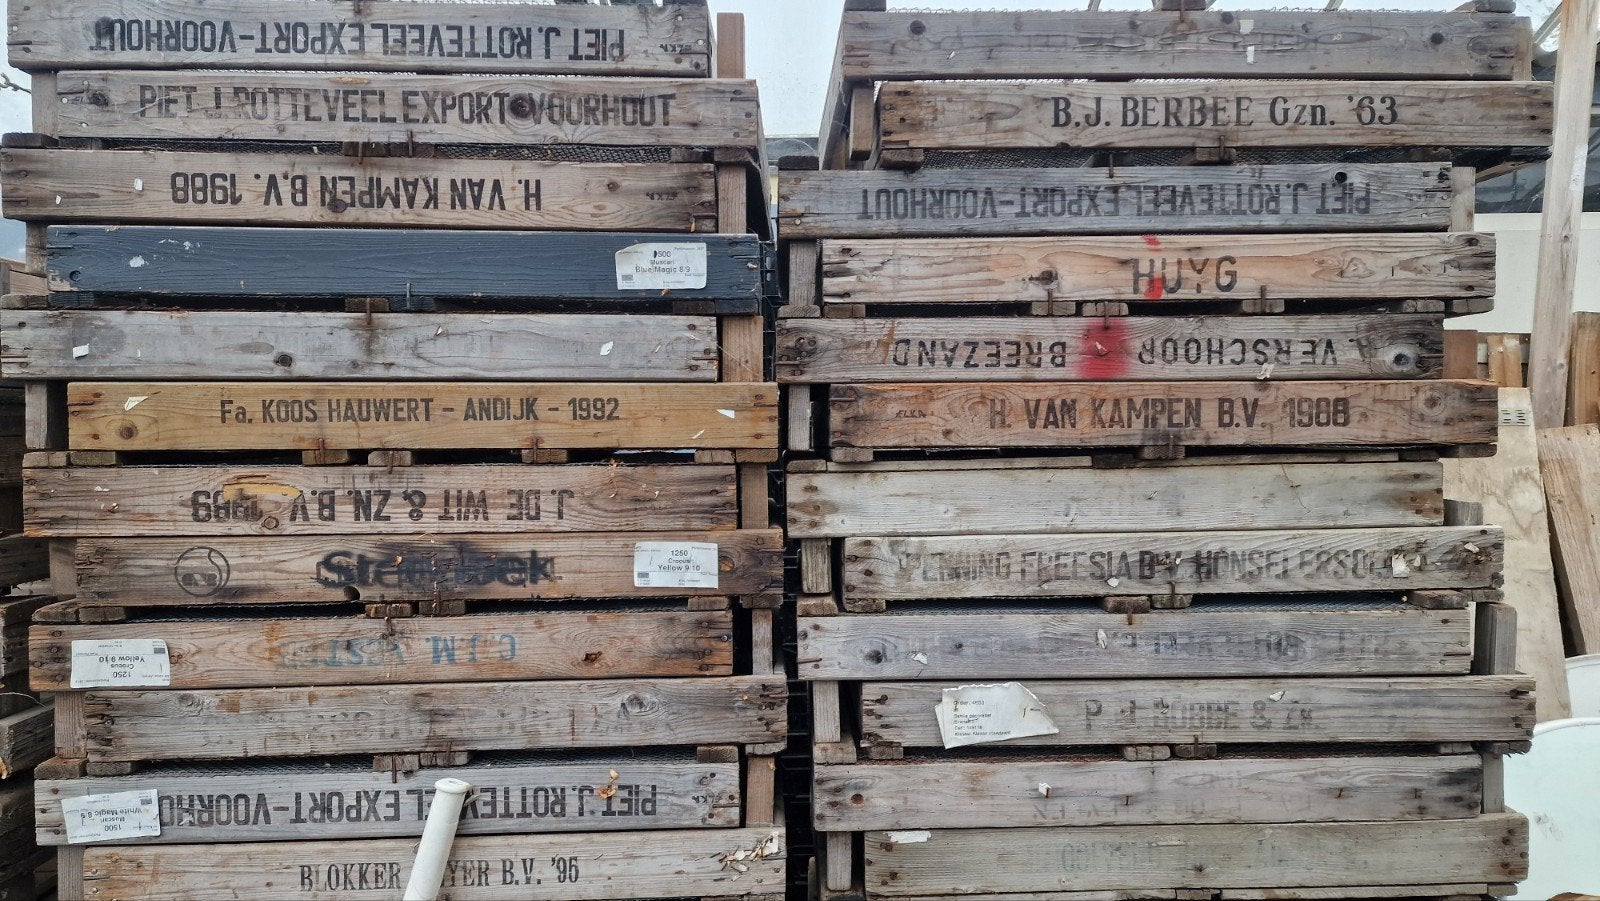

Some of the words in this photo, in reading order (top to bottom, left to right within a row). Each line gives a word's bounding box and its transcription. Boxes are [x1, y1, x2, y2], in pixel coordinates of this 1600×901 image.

[371, 23, 532, 60] ROTTEVEEL
[568, 28, 625, 61] PIET
[139, 84, 198, 118] PIET
[1120, 96, 1253, 128] BERBEE
[1268, 95, 1336, 127] Gzn.
[1347, 94, 1399, 126] '63
[170, 171, 243, 205] 1988
[254, 173, 309, 207] B.V.
[320, 175, 439, 210] KAMPEN
[450, 177, 506, 211] VAN
[517, 178, 542, 211] H.
[1315, 182, 1372, 215] PIET
[635, 265, 653, 273] Blue
[654, 266, 677, 274] Magic
[653, 250, 672, 259] 500
[1132, 255, 1238, 295] HUYG
[892, 337, 1067, 368] BREEZAND
[1138, 337, 1339, 366] VERSCHOOR
[220, 400, 253, 424] Fa.
[262, 399, 318, 423] KOOS
[327, 398, 434, 422] HAUWERT
[463, 397, 539, 422] ANDIJK
[567, 397, 620, 421] 1992
[1024, 398, 1077, 429] VAN
[1090, 397, 1201, 429] KAMPEN
[1282, 397, 1351, 428] 1988
[346, 489, 391, 522] ZN.
[402, 489, 427, 522] &
[437, 489, 490, 522] WIT
[506, 489, 541, 521] DE
[112, 671, 132, 679] 1250
[118, 655, 145, 663] Yellow
[94, 808, 118, 817] Magic
[119, 806, 142, 816] White
[406, 785, 566, 821] ROTTEVL
[601, 784, 658, 818] PIET
[103, 824, 123, 832] 1500
[299, 862, 402, 892] BLOKKER
[440, 858, 490, 888] YER
[501, 857, 542, 886] B.V.
